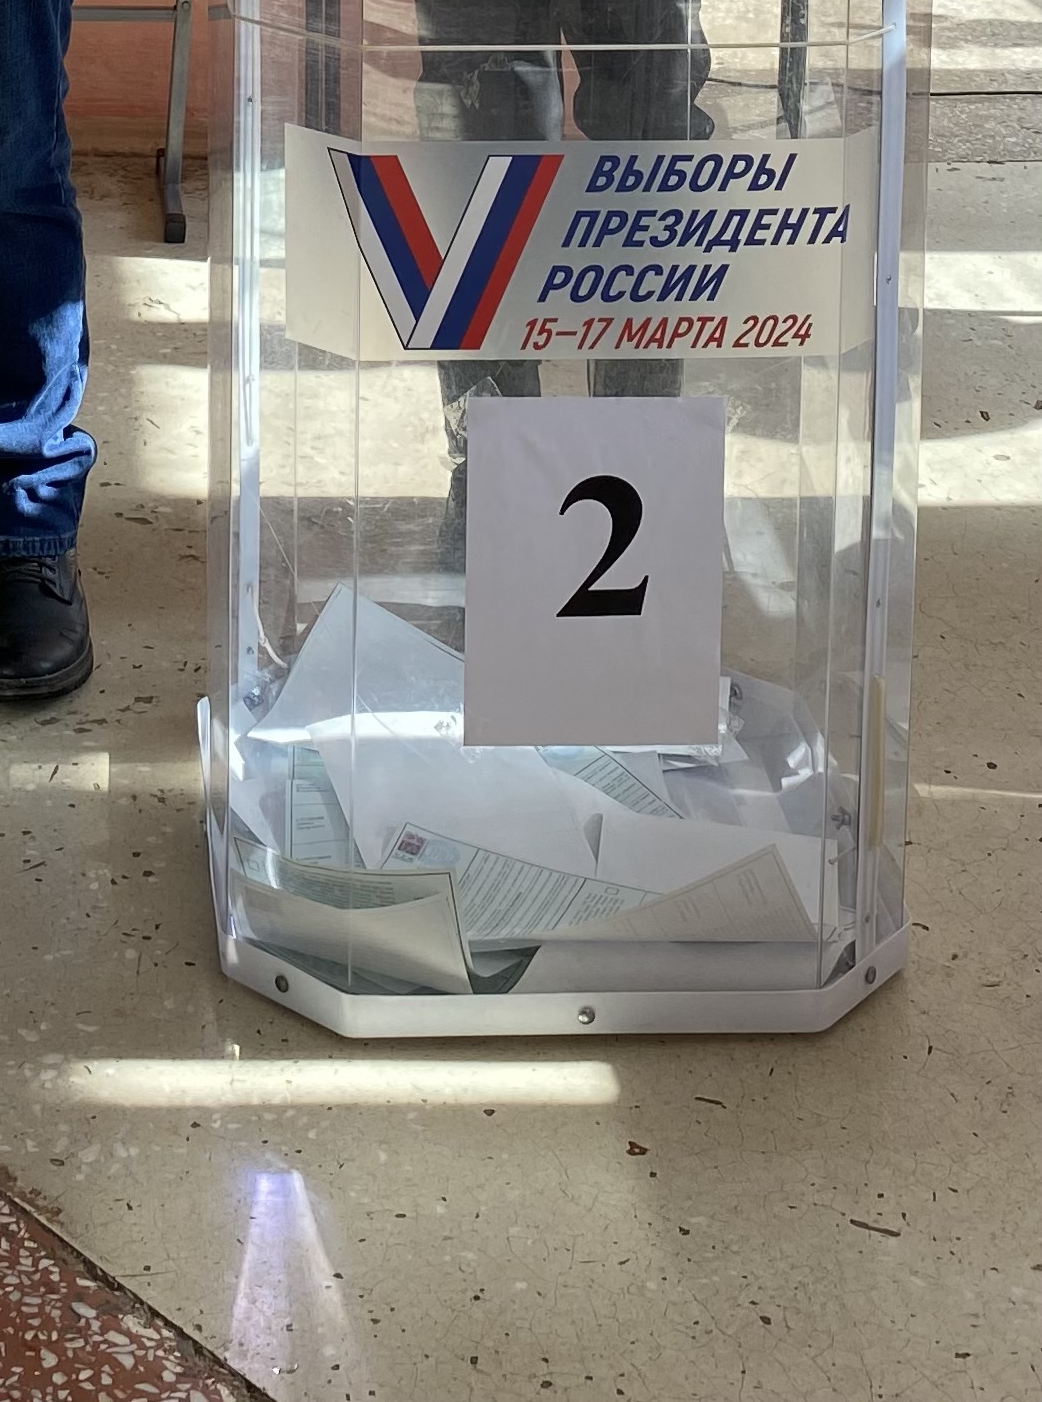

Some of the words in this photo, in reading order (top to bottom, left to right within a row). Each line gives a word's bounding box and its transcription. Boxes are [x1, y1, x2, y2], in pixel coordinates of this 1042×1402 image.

[585, 152, 797, 194] ВЫБОРЫ
[560, 203, 851, 254] ПРЕЗИДЕНТА
[538, 263, 730, 303] РОССИИ
[614, 315, 725, 351] МАРТА
[732, 313, 814, 348] 2024
[556, 474, 649, 618] 2
